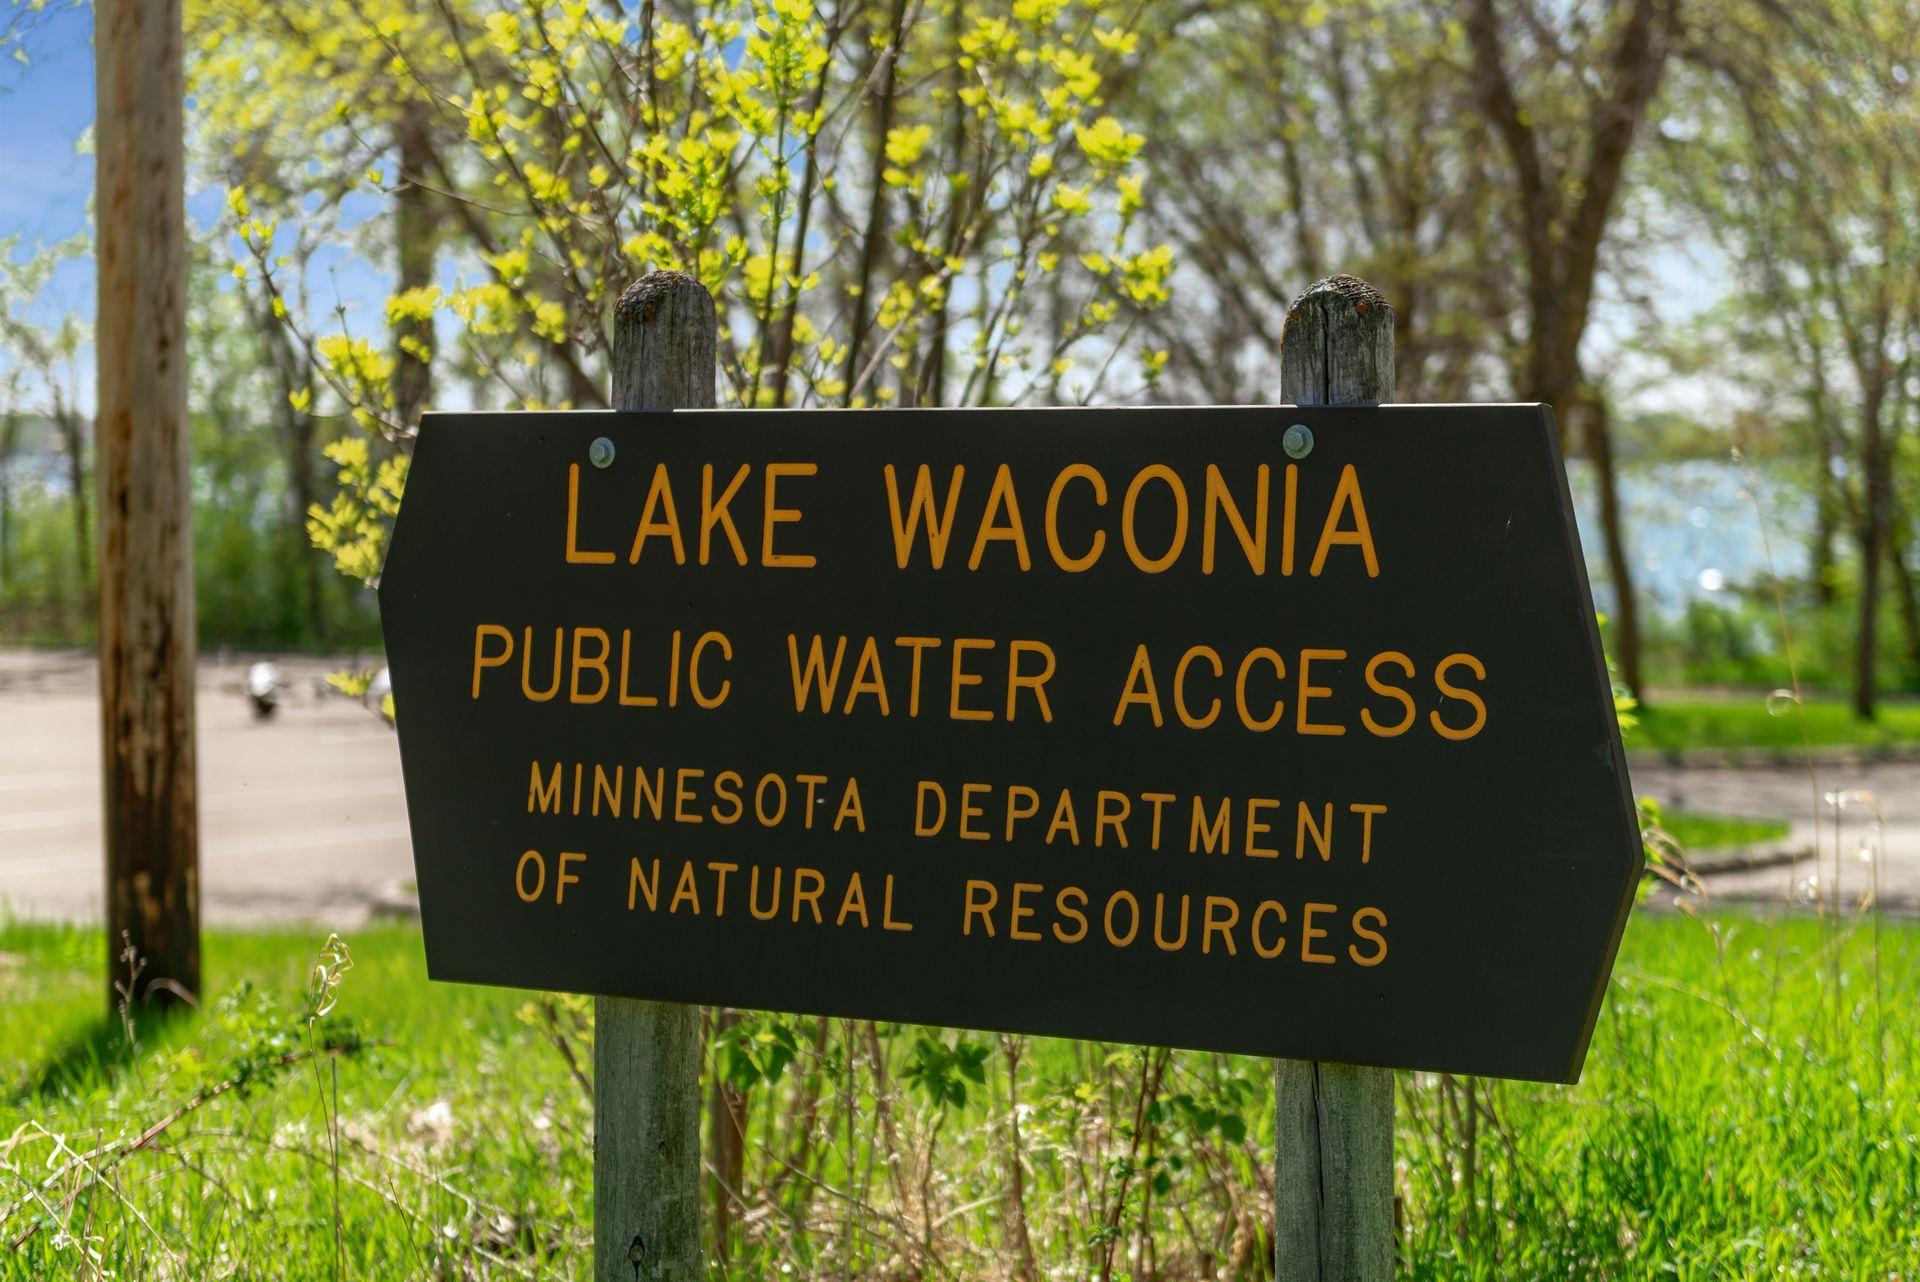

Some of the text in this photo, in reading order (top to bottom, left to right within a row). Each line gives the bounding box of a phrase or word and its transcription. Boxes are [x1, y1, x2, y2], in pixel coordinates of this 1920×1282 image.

[565, 463, 1379, 577] LAKE WACONIA
[472, 624, 1487, 741] PUBLIC WATER ACCESS
[527, 761, 1387, 864] MINNESOTA DEPARTMENT
[515, 850, 1388, 967] OF NATURAL RESOURCES
